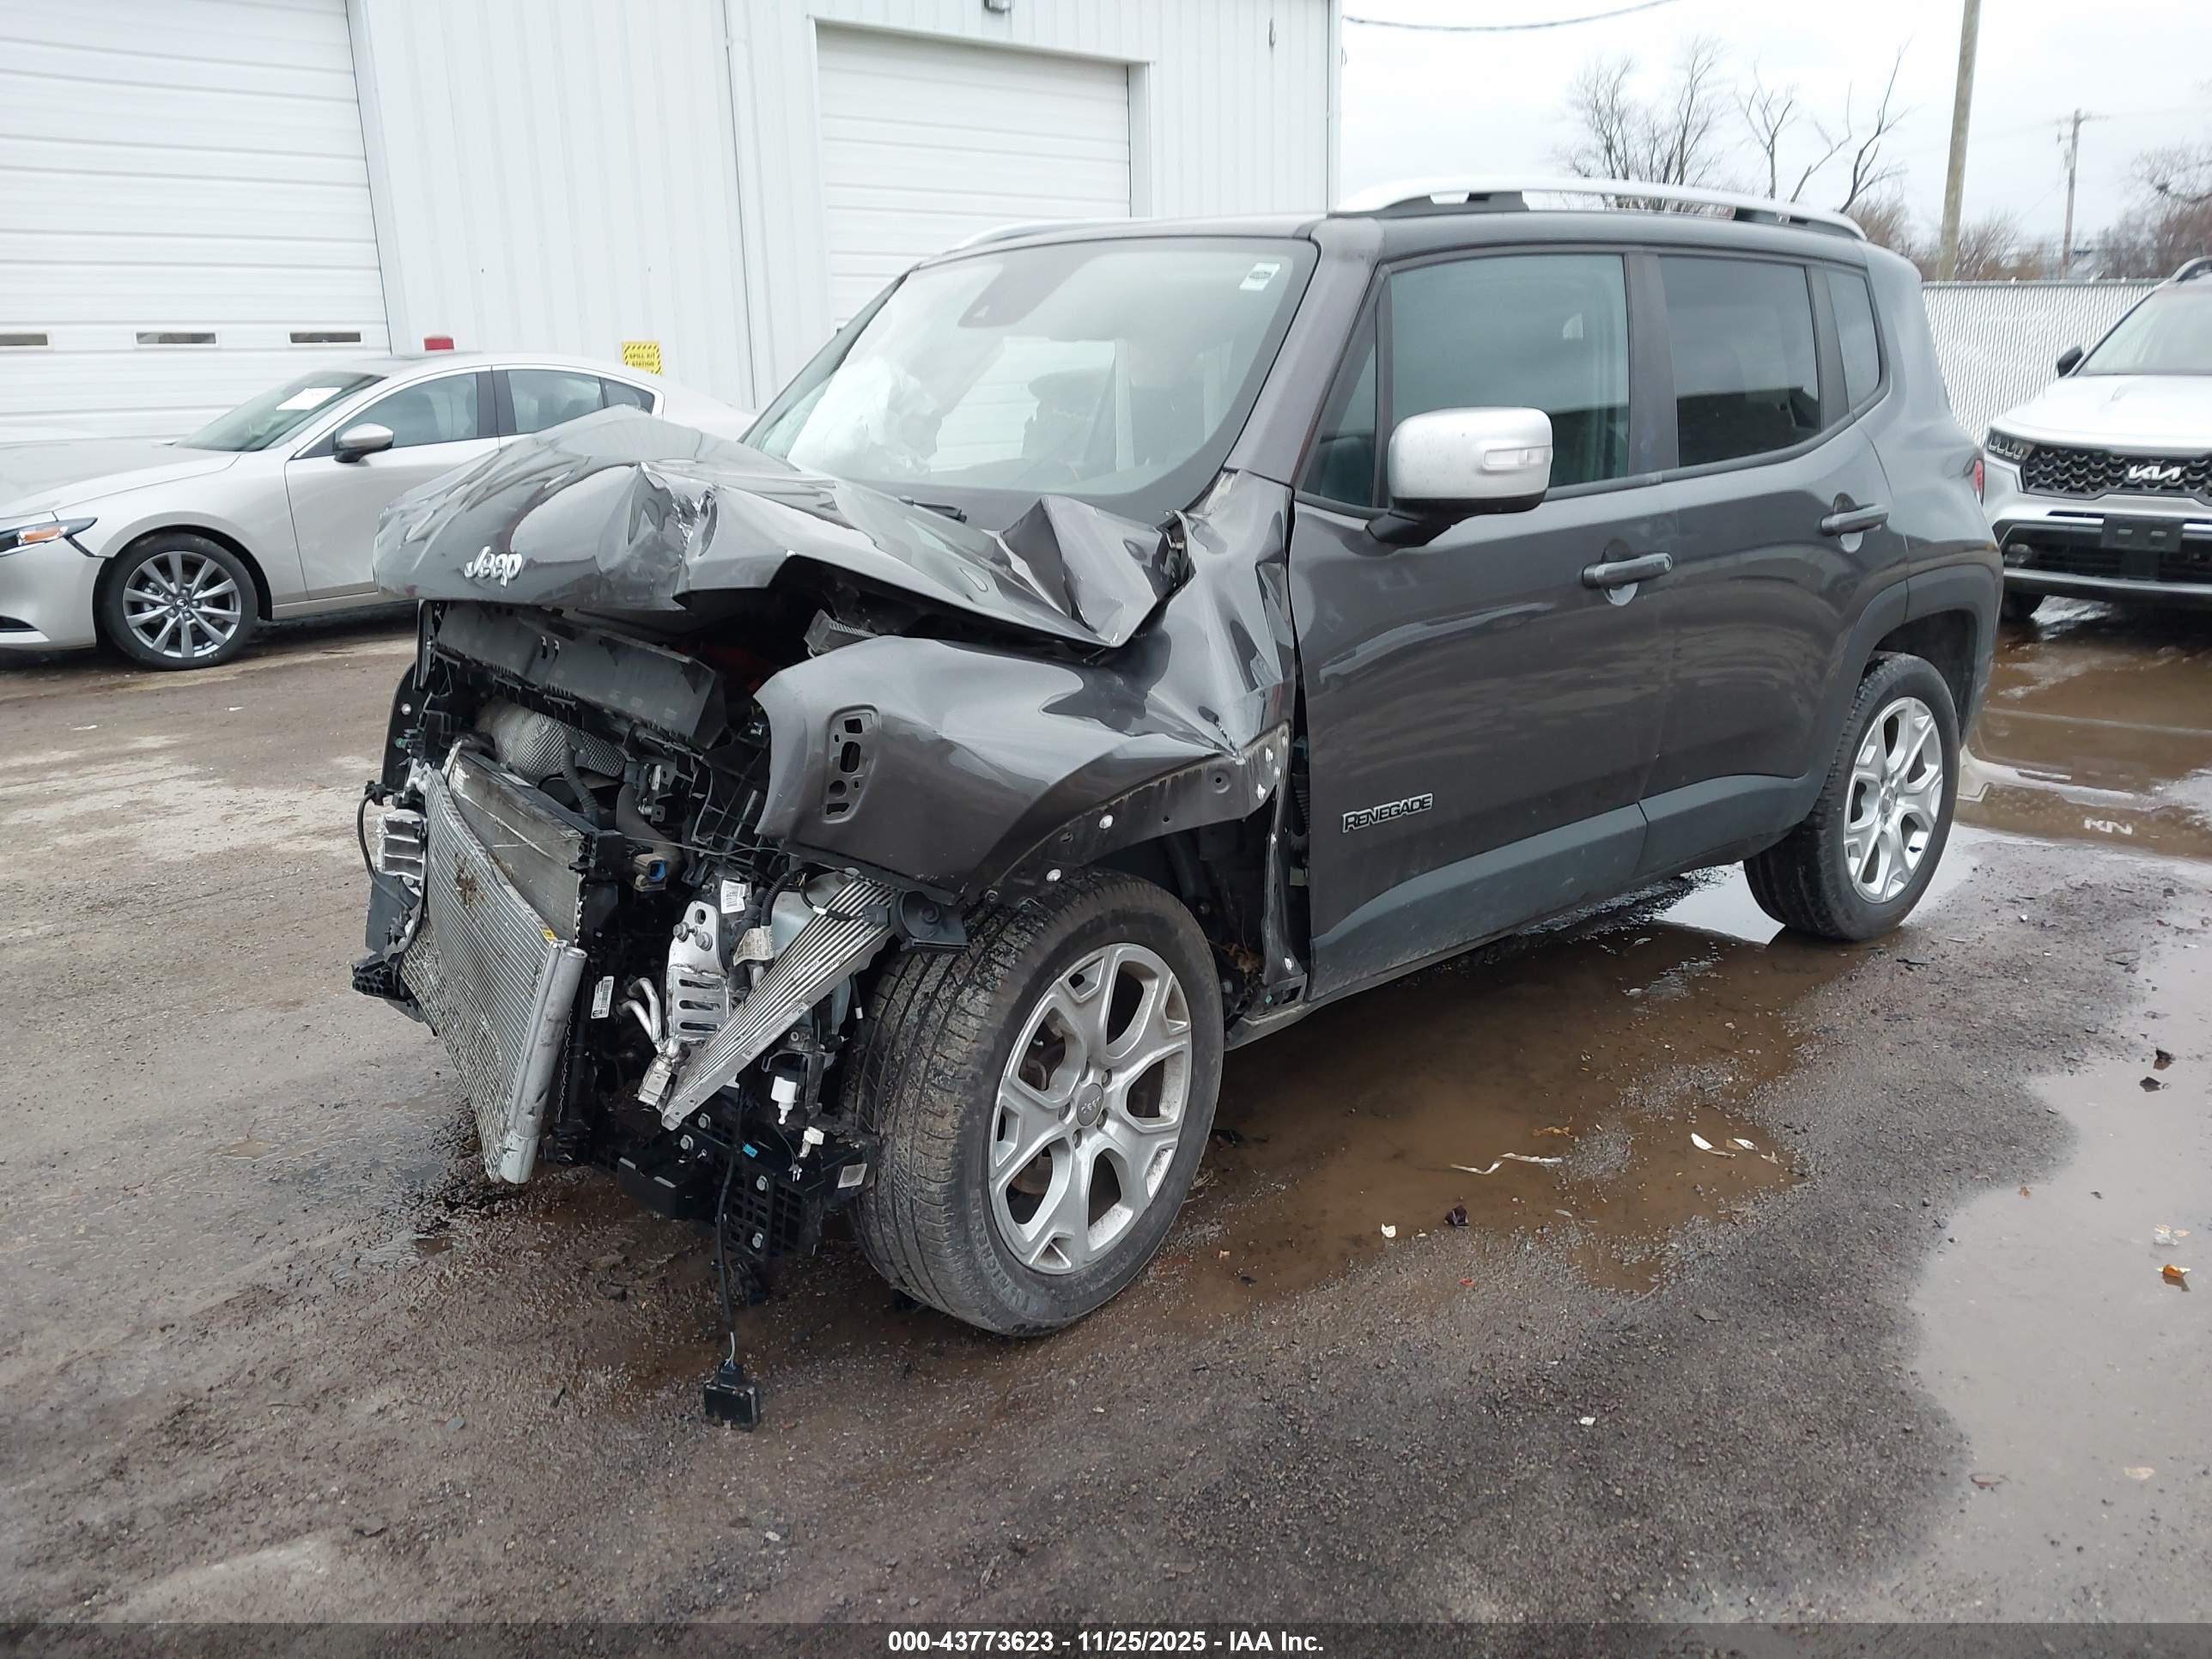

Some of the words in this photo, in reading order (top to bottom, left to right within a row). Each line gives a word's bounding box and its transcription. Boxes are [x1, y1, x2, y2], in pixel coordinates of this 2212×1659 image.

[2129, 465, 2182, 481] KIA
[464, 545, 523, 587] Jeep
[1342, 793, 1433, 833] RENEGADE
